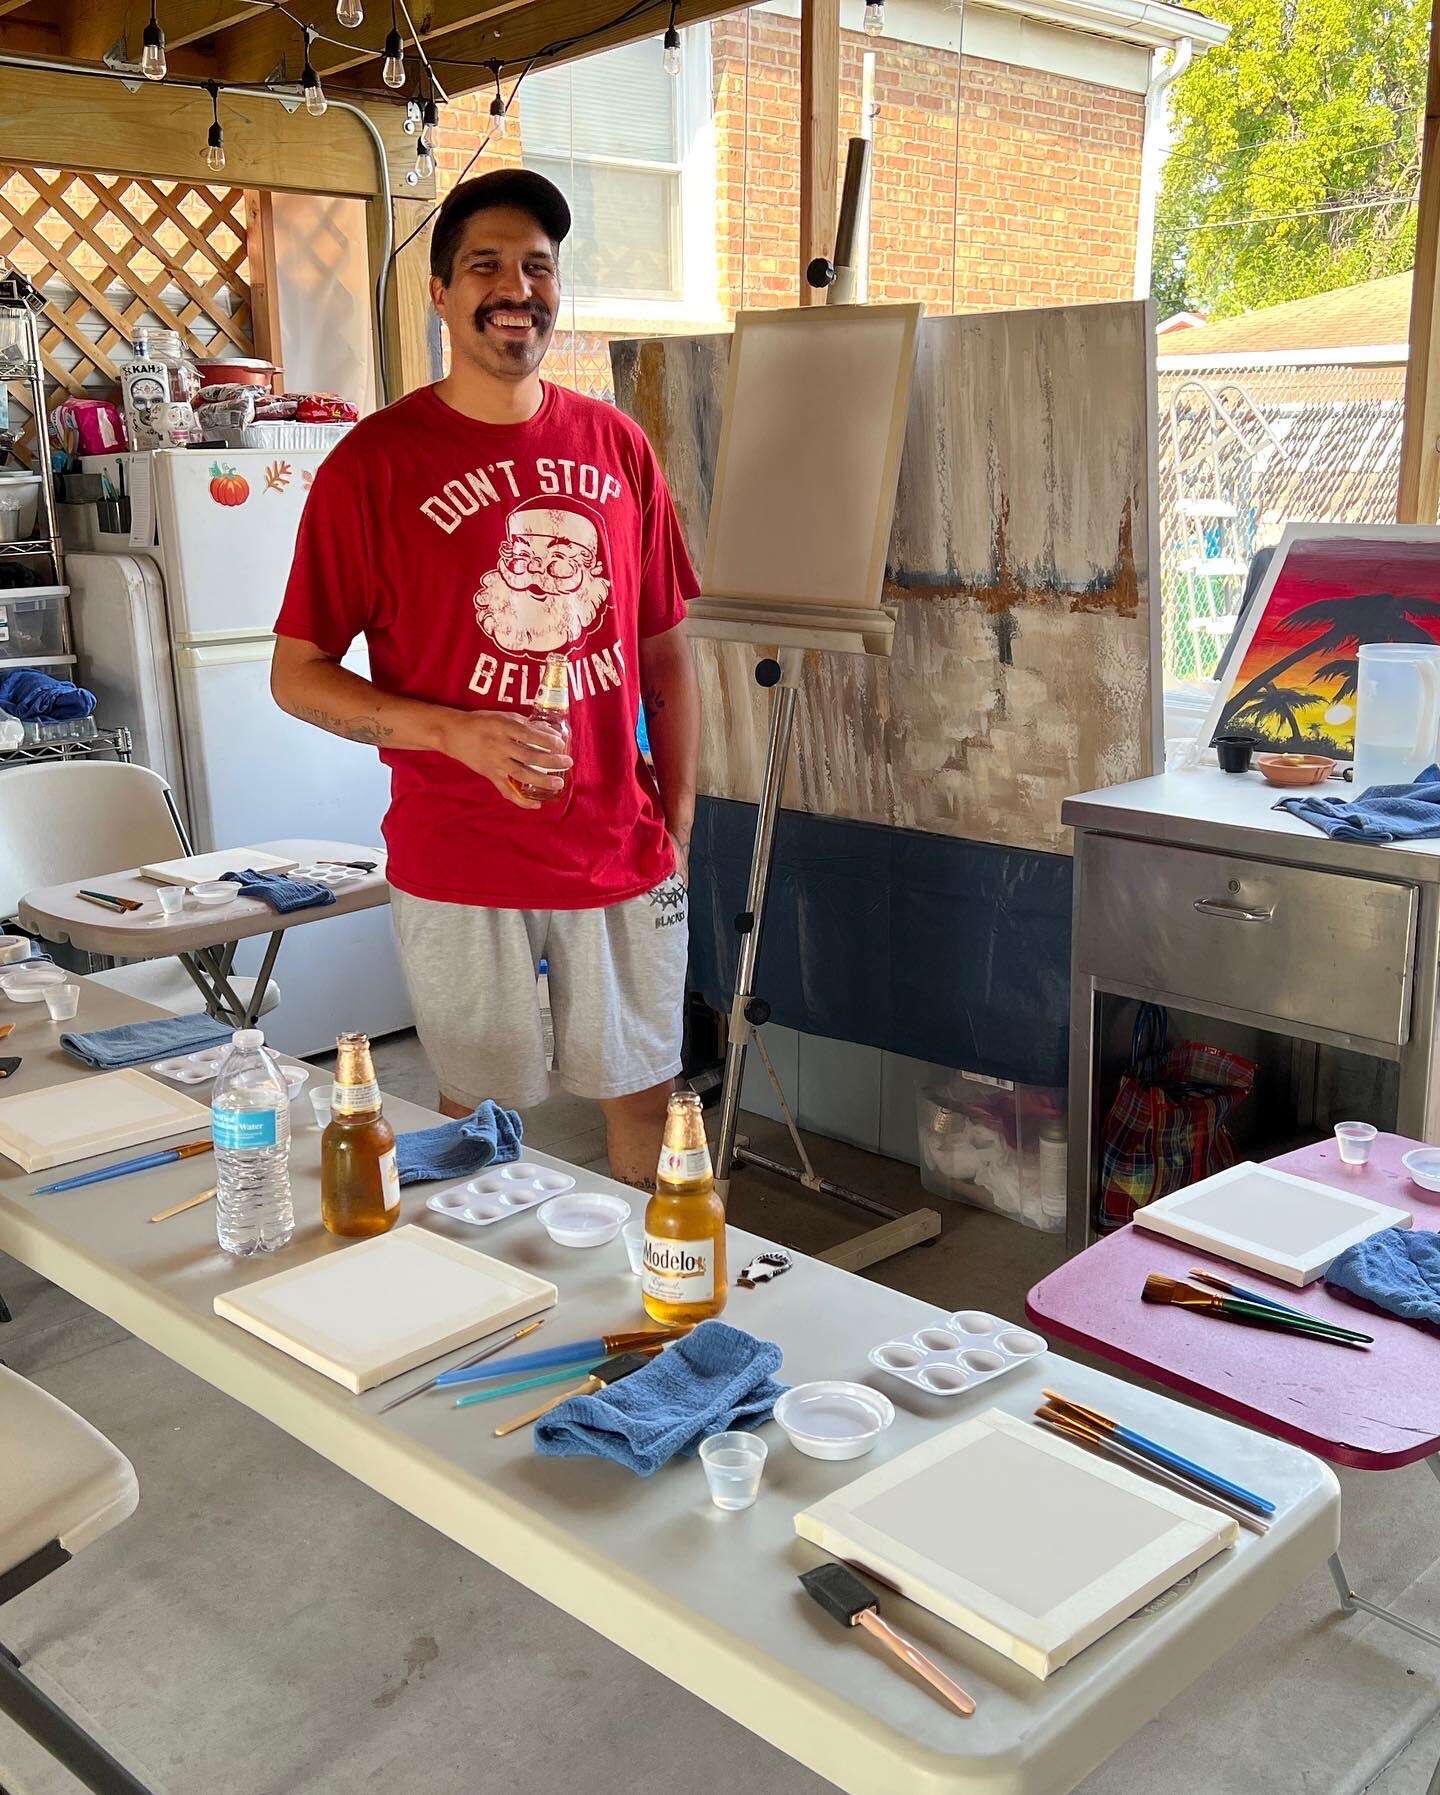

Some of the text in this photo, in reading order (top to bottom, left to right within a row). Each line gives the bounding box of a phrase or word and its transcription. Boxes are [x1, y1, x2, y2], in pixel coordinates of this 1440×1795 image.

[132, 365, 156, 373] KAH
[419, 457, 622, 535] DON'T STOP
[468, 638, 626, 706] BELVIN
[643, 1240, 695, 1270] Modelo
